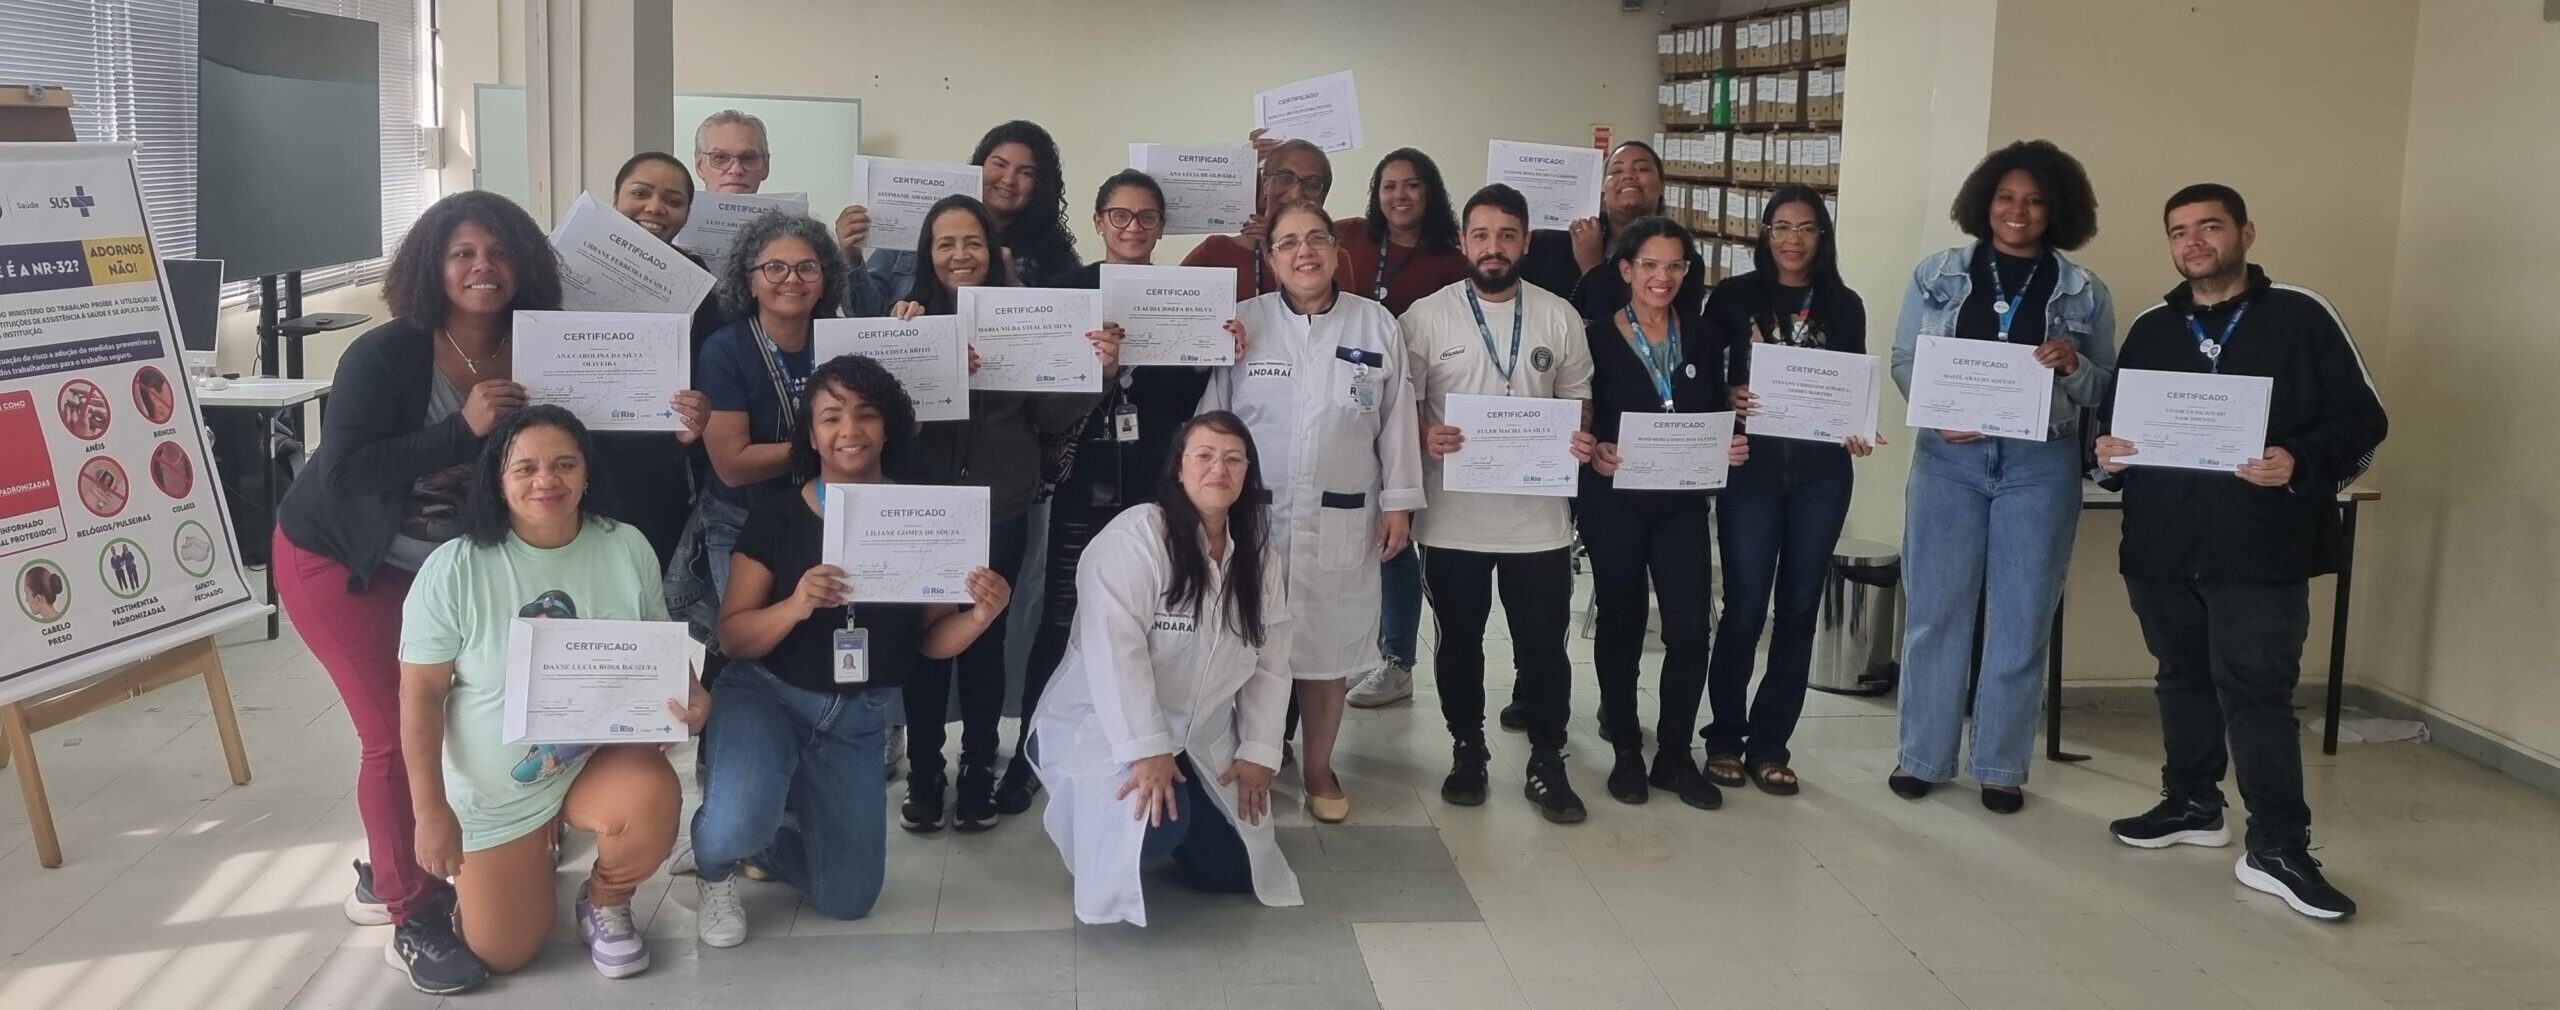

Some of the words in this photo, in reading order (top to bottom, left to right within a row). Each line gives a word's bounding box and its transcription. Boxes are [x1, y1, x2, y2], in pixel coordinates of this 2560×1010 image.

[1178, 155, 1229, 164] CERTIFICADO
[1520, 156, 1565, 165] CERTIFICADO
[893, 176, 945, 187] CERTIFICADO
[16, 201, 39, 209] Saúde
[50, 197, 70, 209] SUS
[90, 244, 144, 258] ADORNOS
[609, 233, 667, 270] CERTIFICADO
[8, 260, 16, 278] É
[20, 264, 30, 277] A
[32, 260, 80, 275] NR-32?
[108, 260, 138, 275] NÃO!
[8, 307, 44, 317] MINISTÉRIO
[56, 303, 90, 312] TRABALHO
[91, 299, 113, 308] PROÍBE
[995, 306, 1054, 315] CERTIFICADO
[42, 313, 80, 324] ASSISTÊNCIA
[3, 327, 45, 338] INSTITUIÇÃO.
[564, 332, 635, 341] CERTIFICADO
[858, 329, 919, 339] CERTIFICADO
[32, 352, 48, 360] risco
[55, 348, 77, 358] adoção
[88, 343, 115, 352] medidas
[116, 340, 148, 351] preventivas
[12, 363, 59, 375] trabalhadores
[60, 360, 74, 369] para
[81, 355, 108, 365] trabalho
[109, 352, 133, 361] seguro.
[1953, 358, 2008, 368] CERTIFICADO
[1248, 368, 1292, 377] ANDARAÍ
[1787, 365, 1839, 376] CERTIFICADO
[2166, 392, 2228, 401] CERTIFICADO
[3, 400, 25, 409] COMO
[154, 428, 176, 438] BRINCOS
[85, 442, 105, 453] ANÉIS
[172, 502, 196, 513] COLARES
[880, 509, 946, 517] CERTIFICADO
[77, 514, 152, 538] RELÓGIOS/PULSEIRAS
[11, 526, 57, 544] PROTEGIDO!!
[195, 580, 215, 592] SAPATO
[194, 588, 223, 603] FECHADO
[112, 596, 159, 616] VESTIMENTAS
[112, 605, 166, 628] PADRONIZADAS
[41, 621, 71, 636] CABELO
[1152, 620, 1196, 632] NDARA
[48, 633, 72, 647] PRESO
[566, 642, 638, 651] CERTIFICADO
